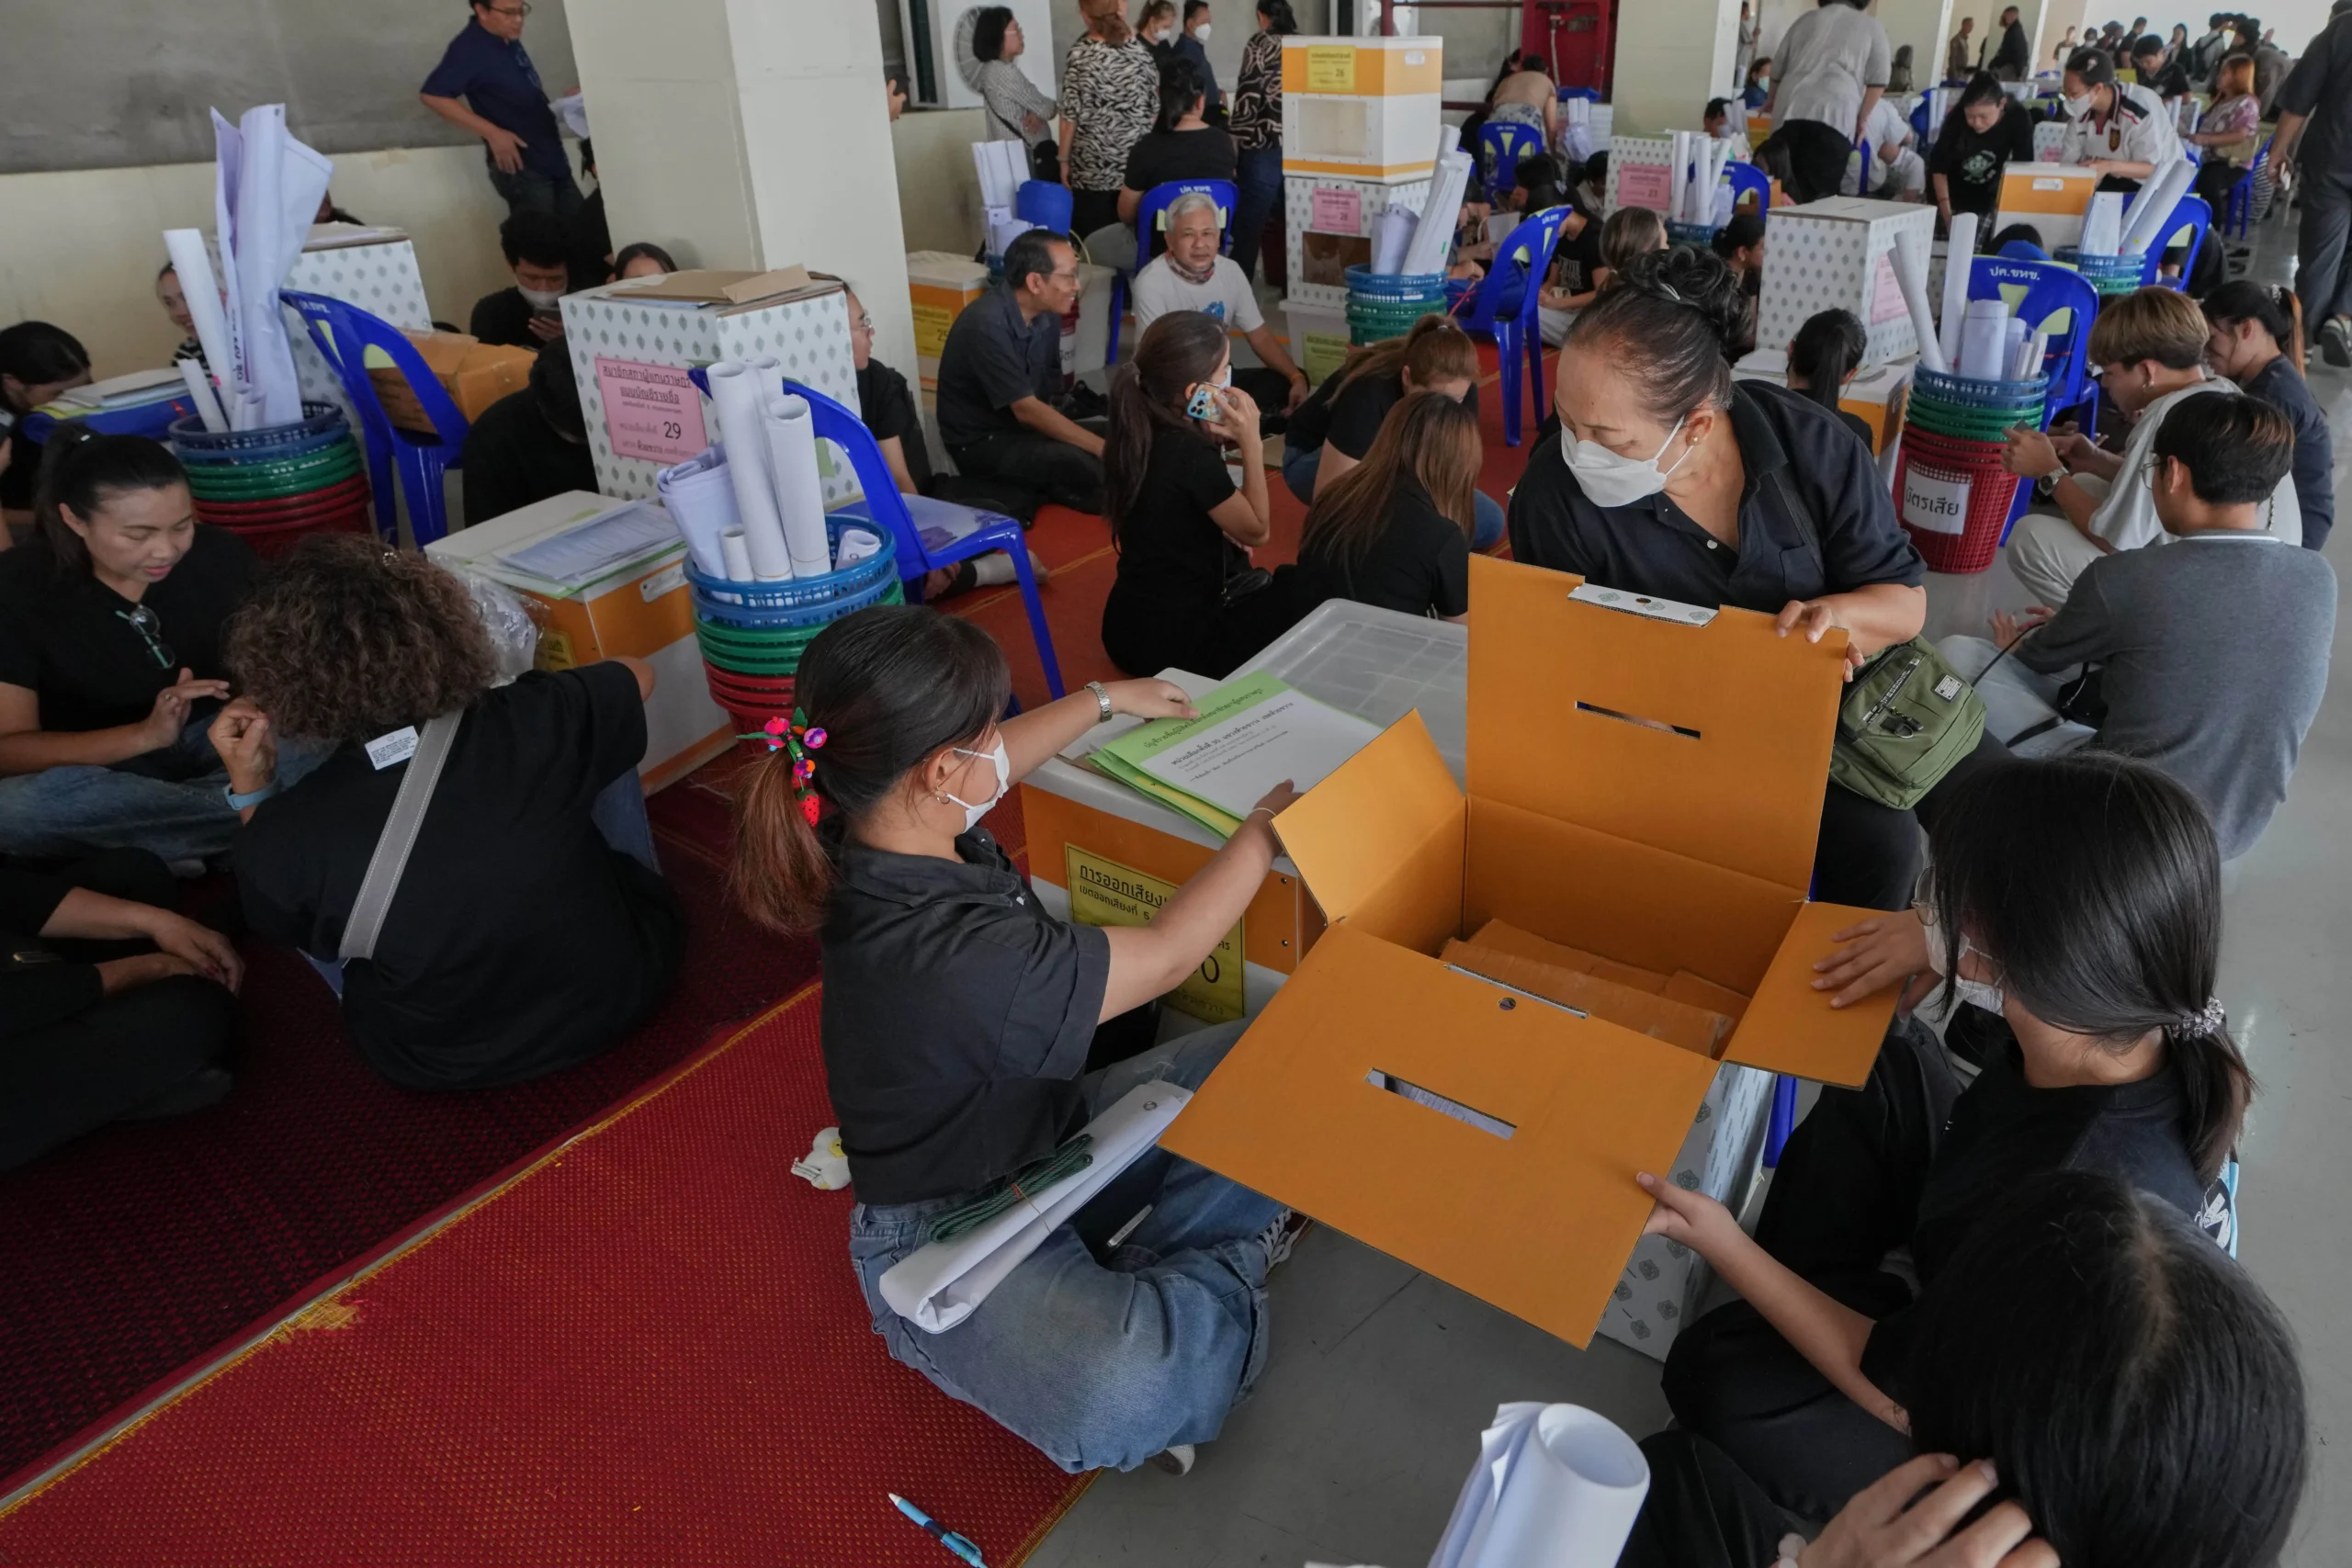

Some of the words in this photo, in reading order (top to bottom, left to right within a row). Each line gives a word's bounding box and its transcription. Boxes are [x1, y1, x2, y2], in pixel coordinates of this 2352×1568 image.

[662, 421, 682, 440] 29
[1905, 485, 1960, 516] บัตรเสีย
[1080, 864, 1168, 908] การออกเสียง
[1080, 885, 1138, 916] เขตออกเสียงที่
